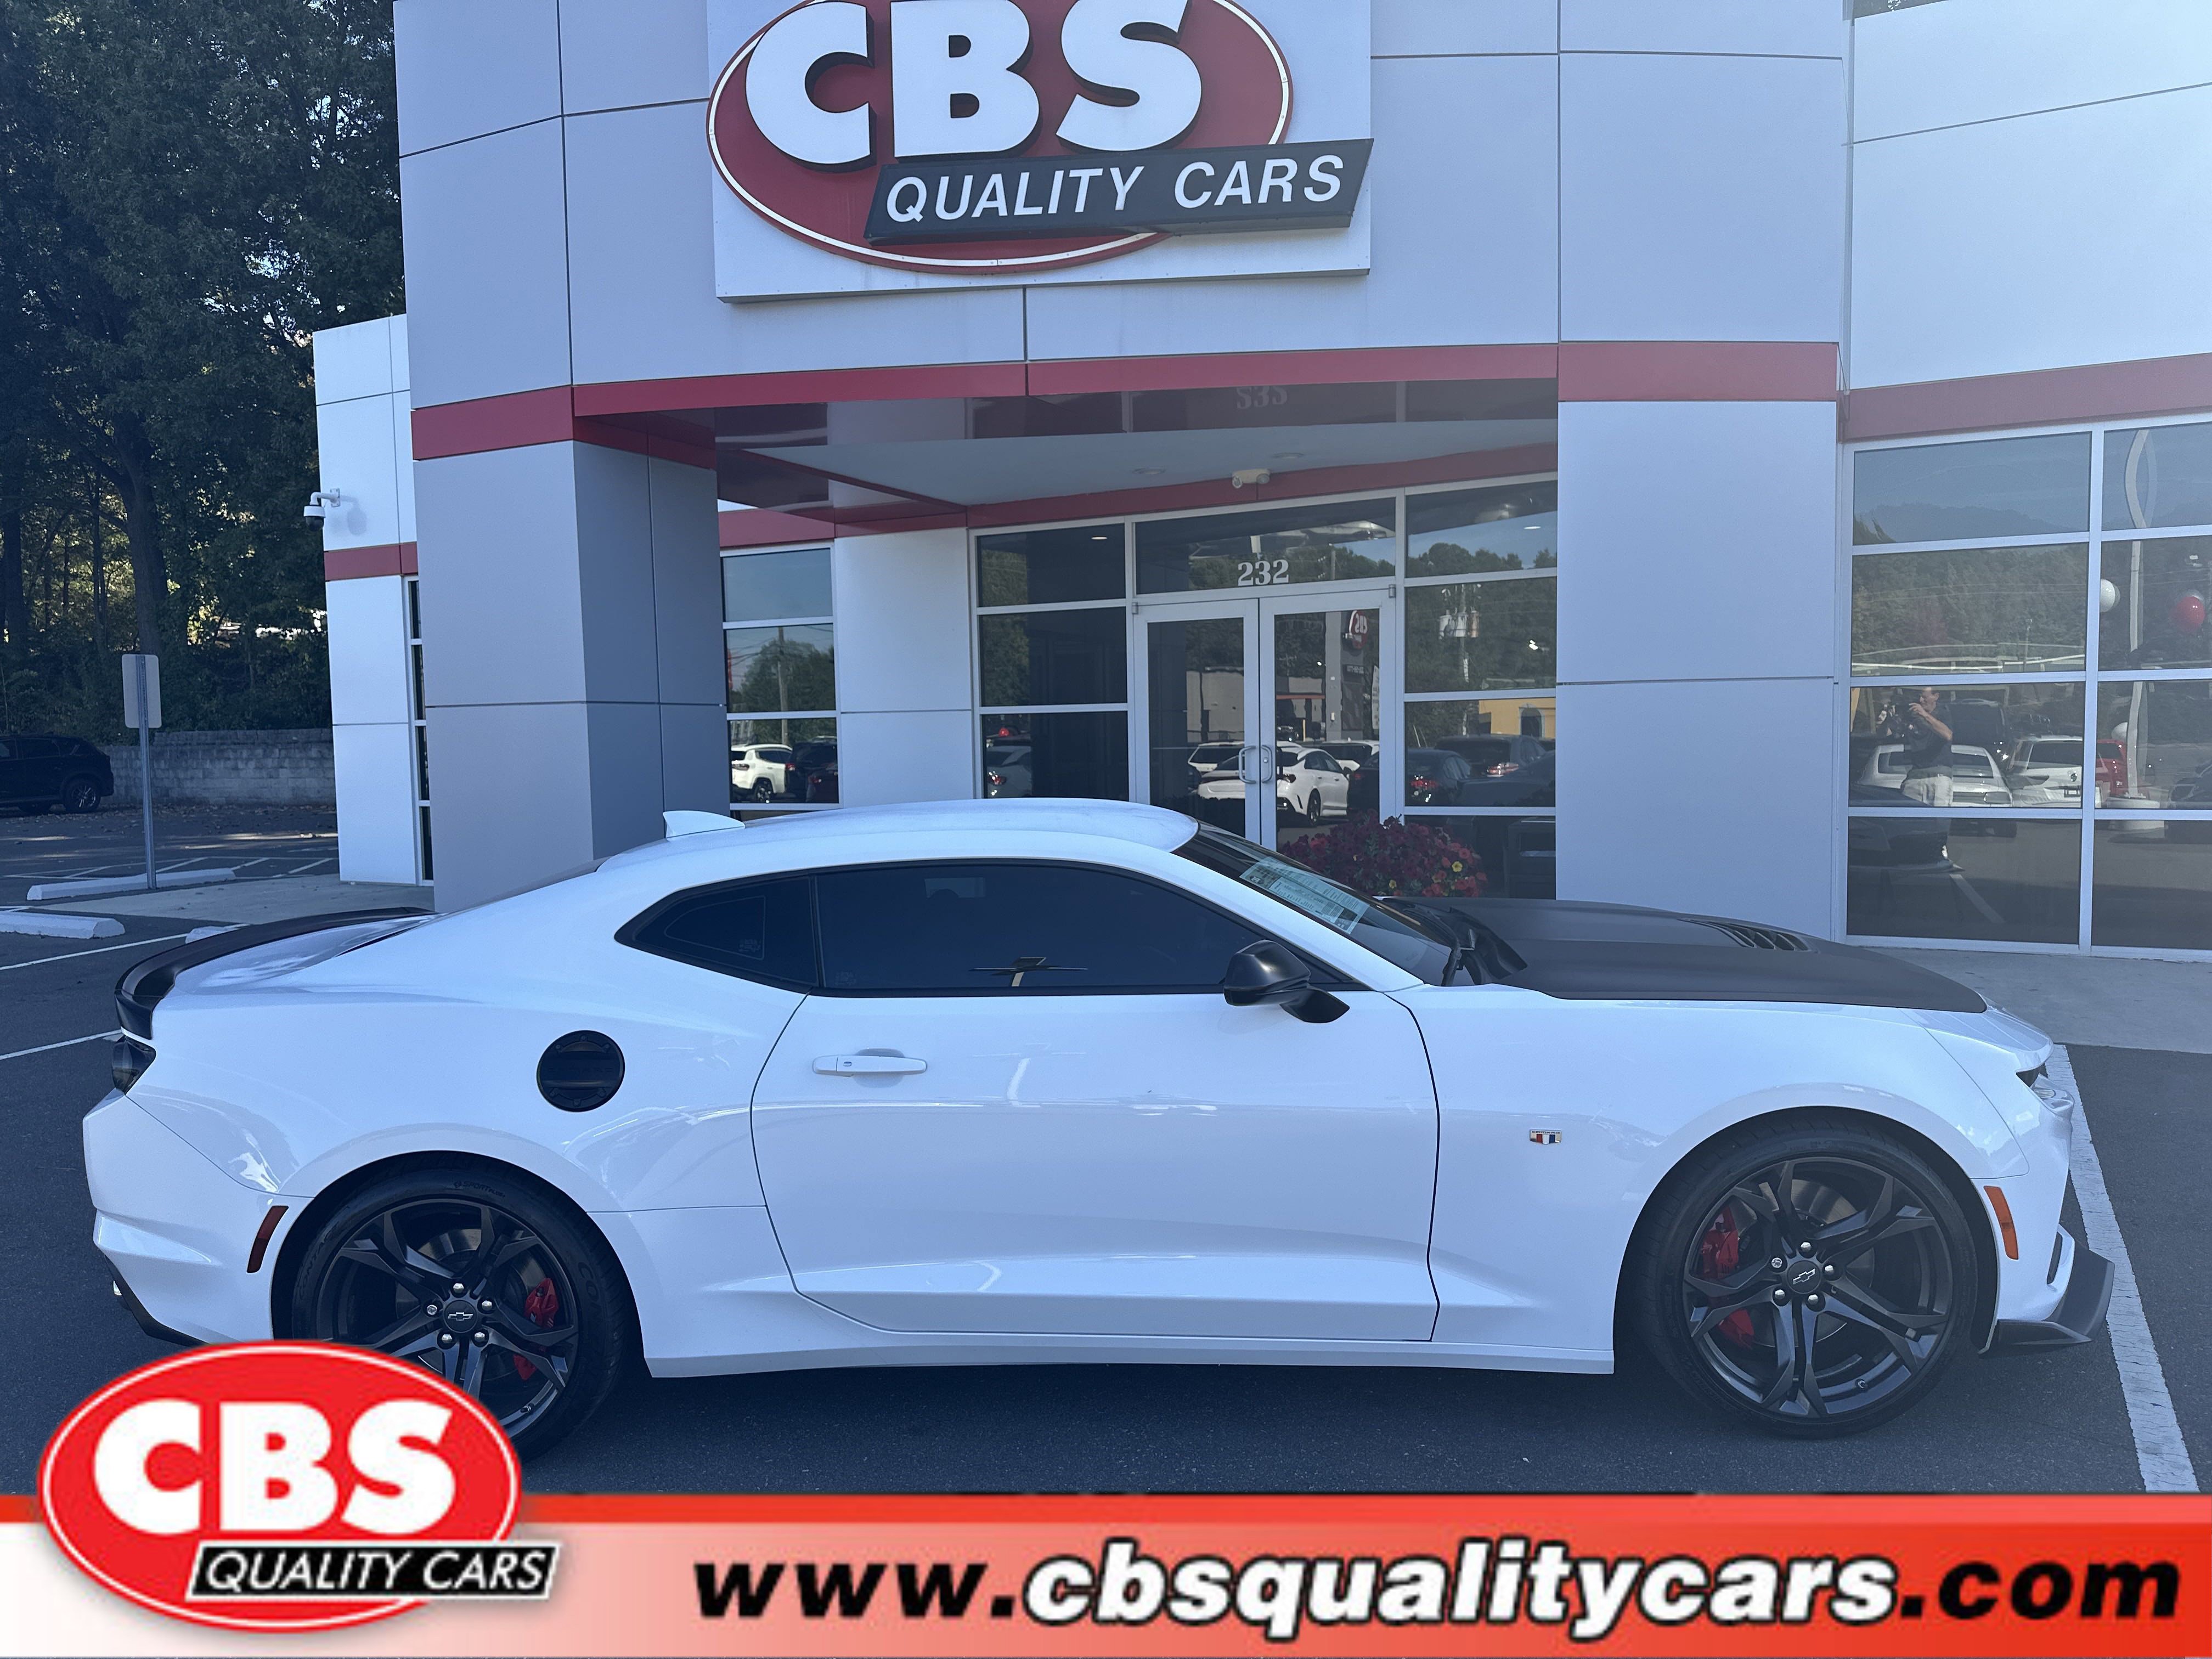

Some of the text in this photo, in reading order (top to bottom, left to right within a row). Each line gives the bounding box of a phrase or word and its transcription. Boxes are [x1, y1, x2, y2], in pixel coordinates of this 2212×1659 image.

[745, 0, 1202, 165] CBS
[884, 154, 1344, 223] QUALITY CARS
[1238, 559, 1289, 586] 232
